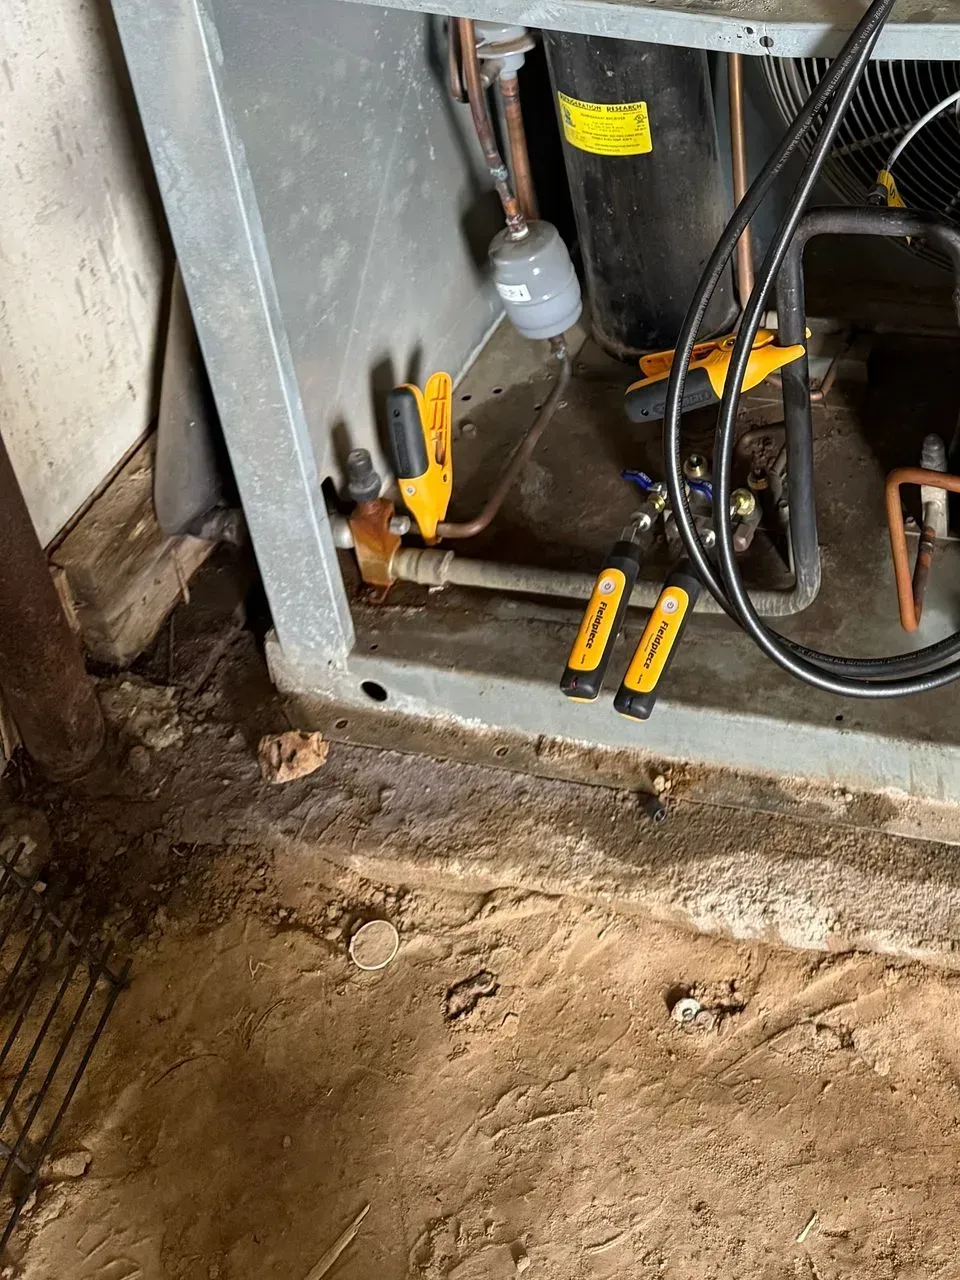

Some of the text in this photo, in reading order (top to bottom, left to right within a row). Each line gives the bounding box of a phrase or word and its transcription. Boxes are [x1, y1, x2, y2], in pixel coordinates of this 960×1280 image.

[606, 102, 642, 113] RESEARCH
[585, 600, 608, 650] Fieldpiece
[643, 620, 670, 670] Fieldpiece
